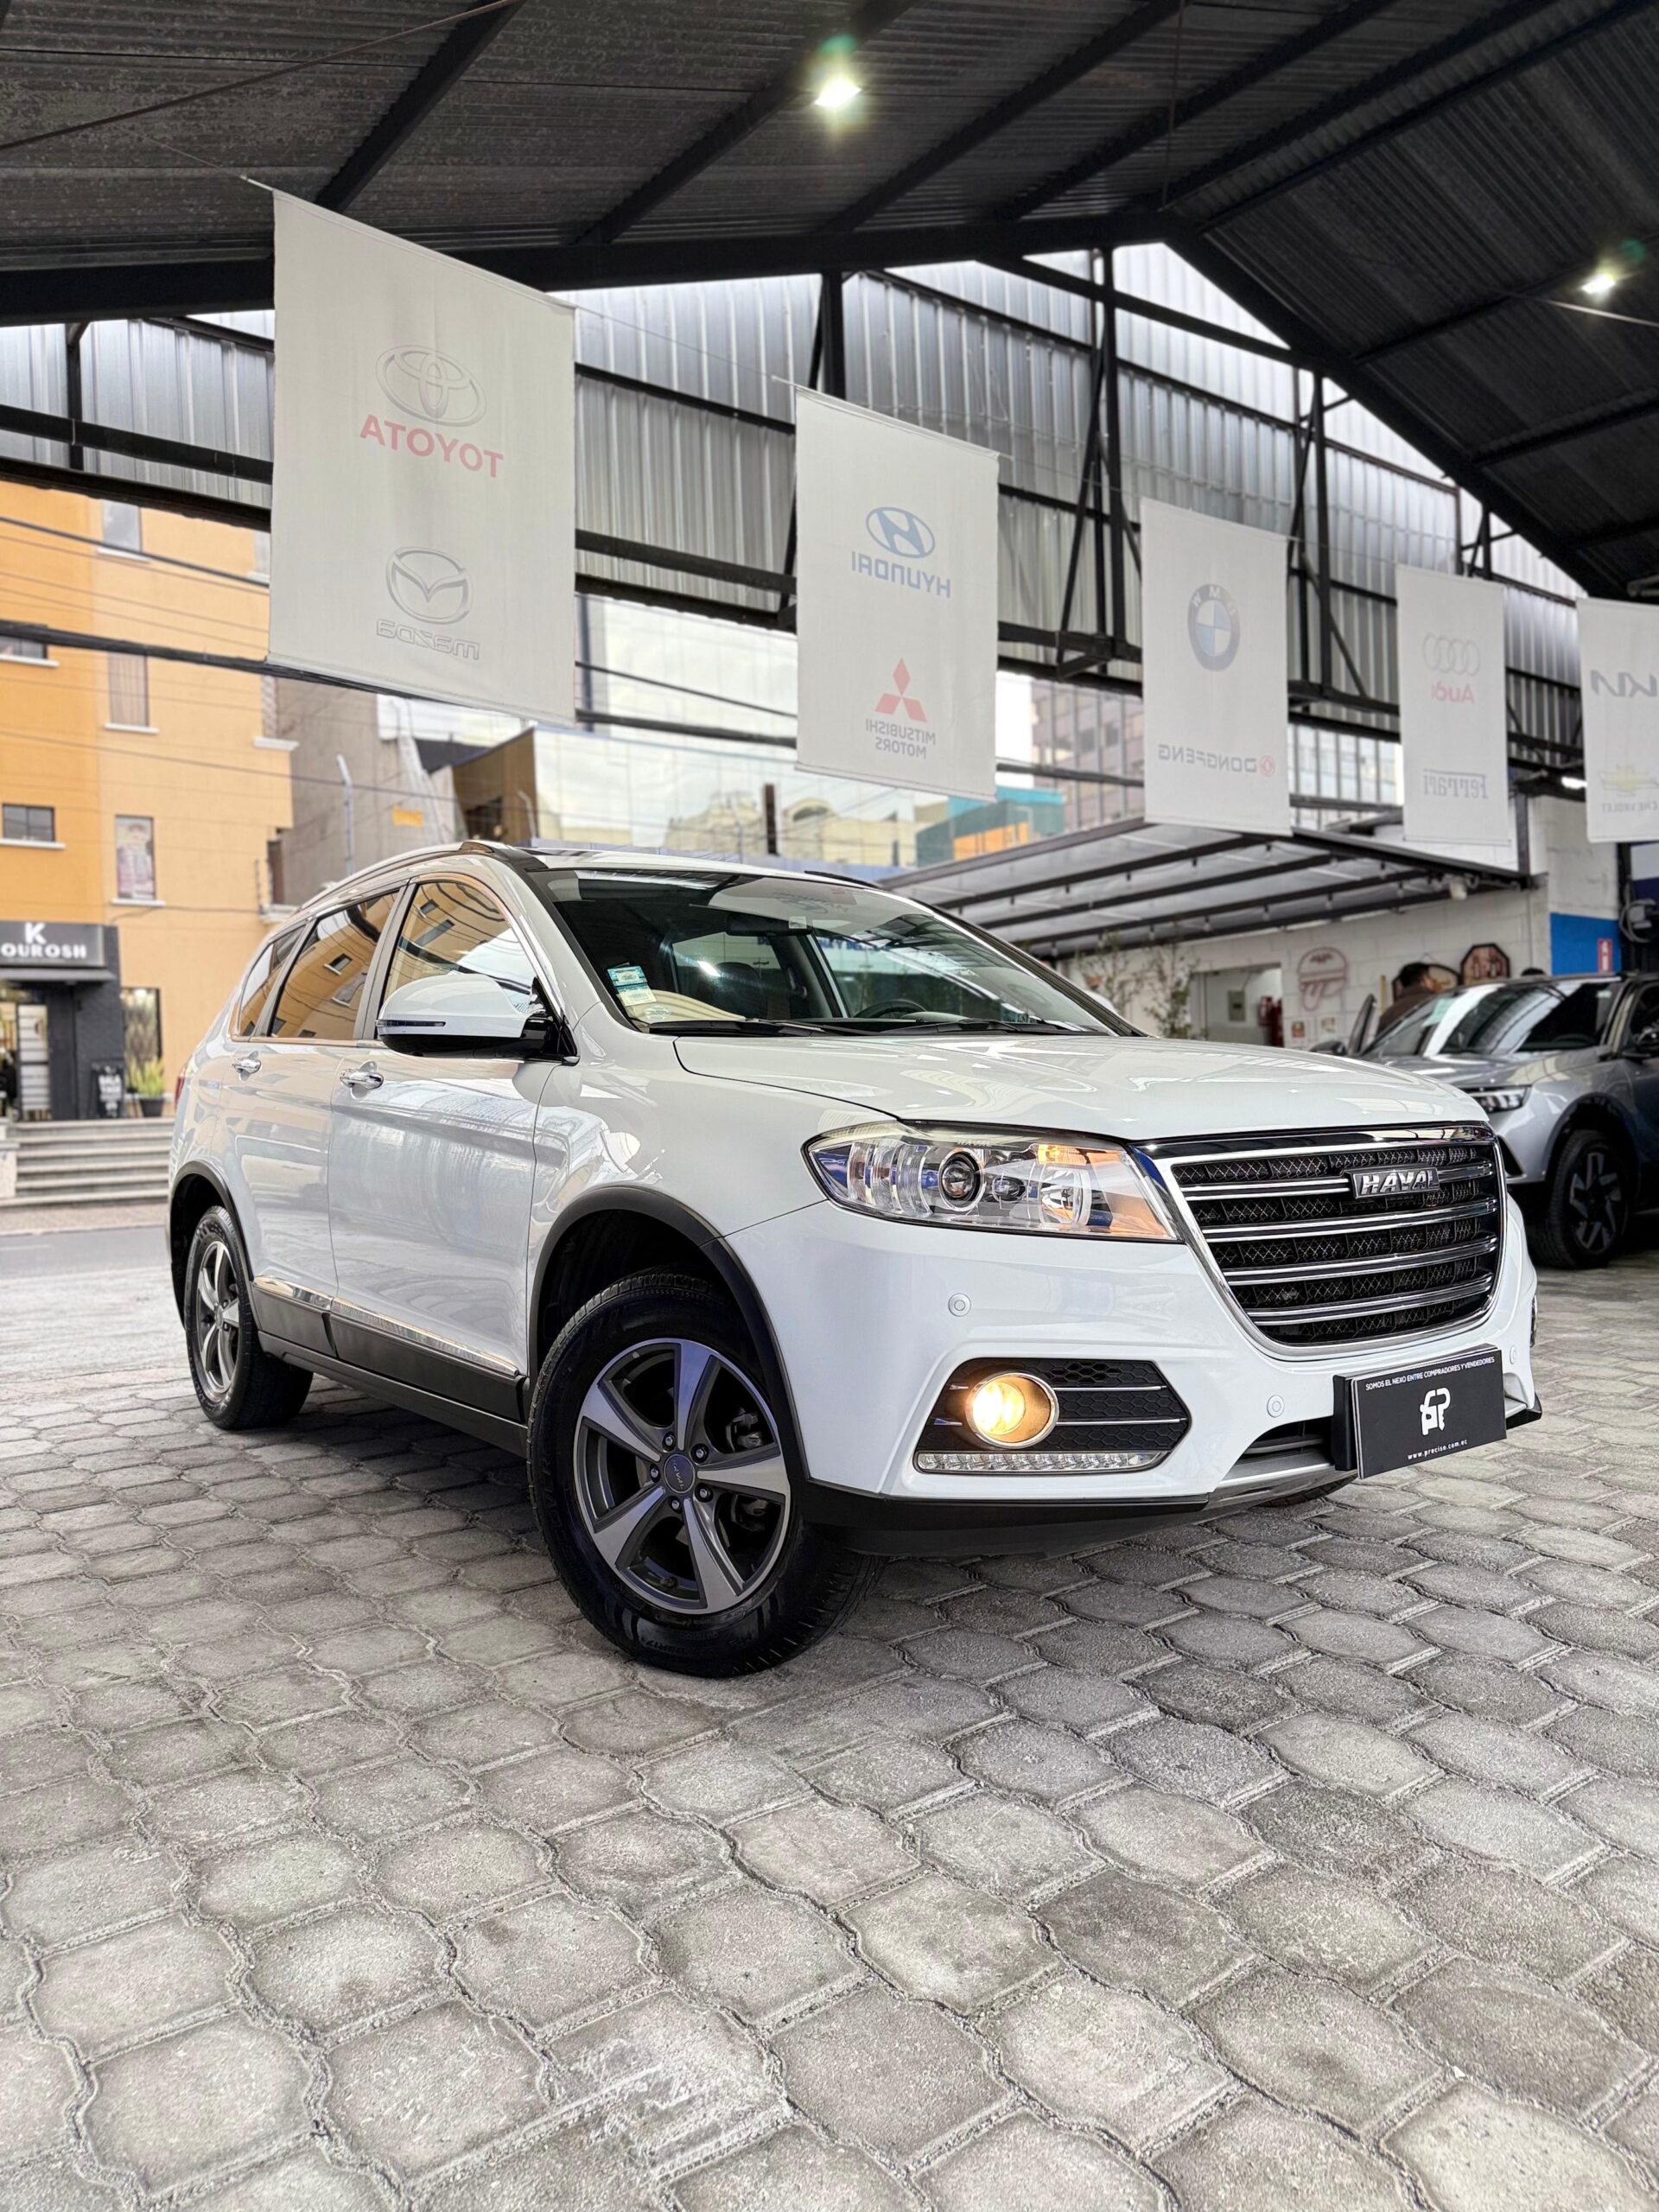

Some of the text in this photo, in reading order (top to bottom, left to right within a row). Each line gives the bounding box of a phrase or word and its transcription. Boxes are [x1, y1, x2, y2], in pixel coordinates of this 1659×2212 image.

[24, 921, 47, 944] K
[1360, 1169, 1439, 1195] HAVAL
[1365, 1380, 1385, 1391] SOMOS
[1392, 1376, 1407, 1385] NEXO
[1407, 1372, 1424, 1382] ENTRE
[1423, 1364, 1461, 1378] COMPRADORES
[1464, 1356, 1495, 1370] VENDEDORES
[1407, 1439, 1468, 1460] www.preciso.com.ec
